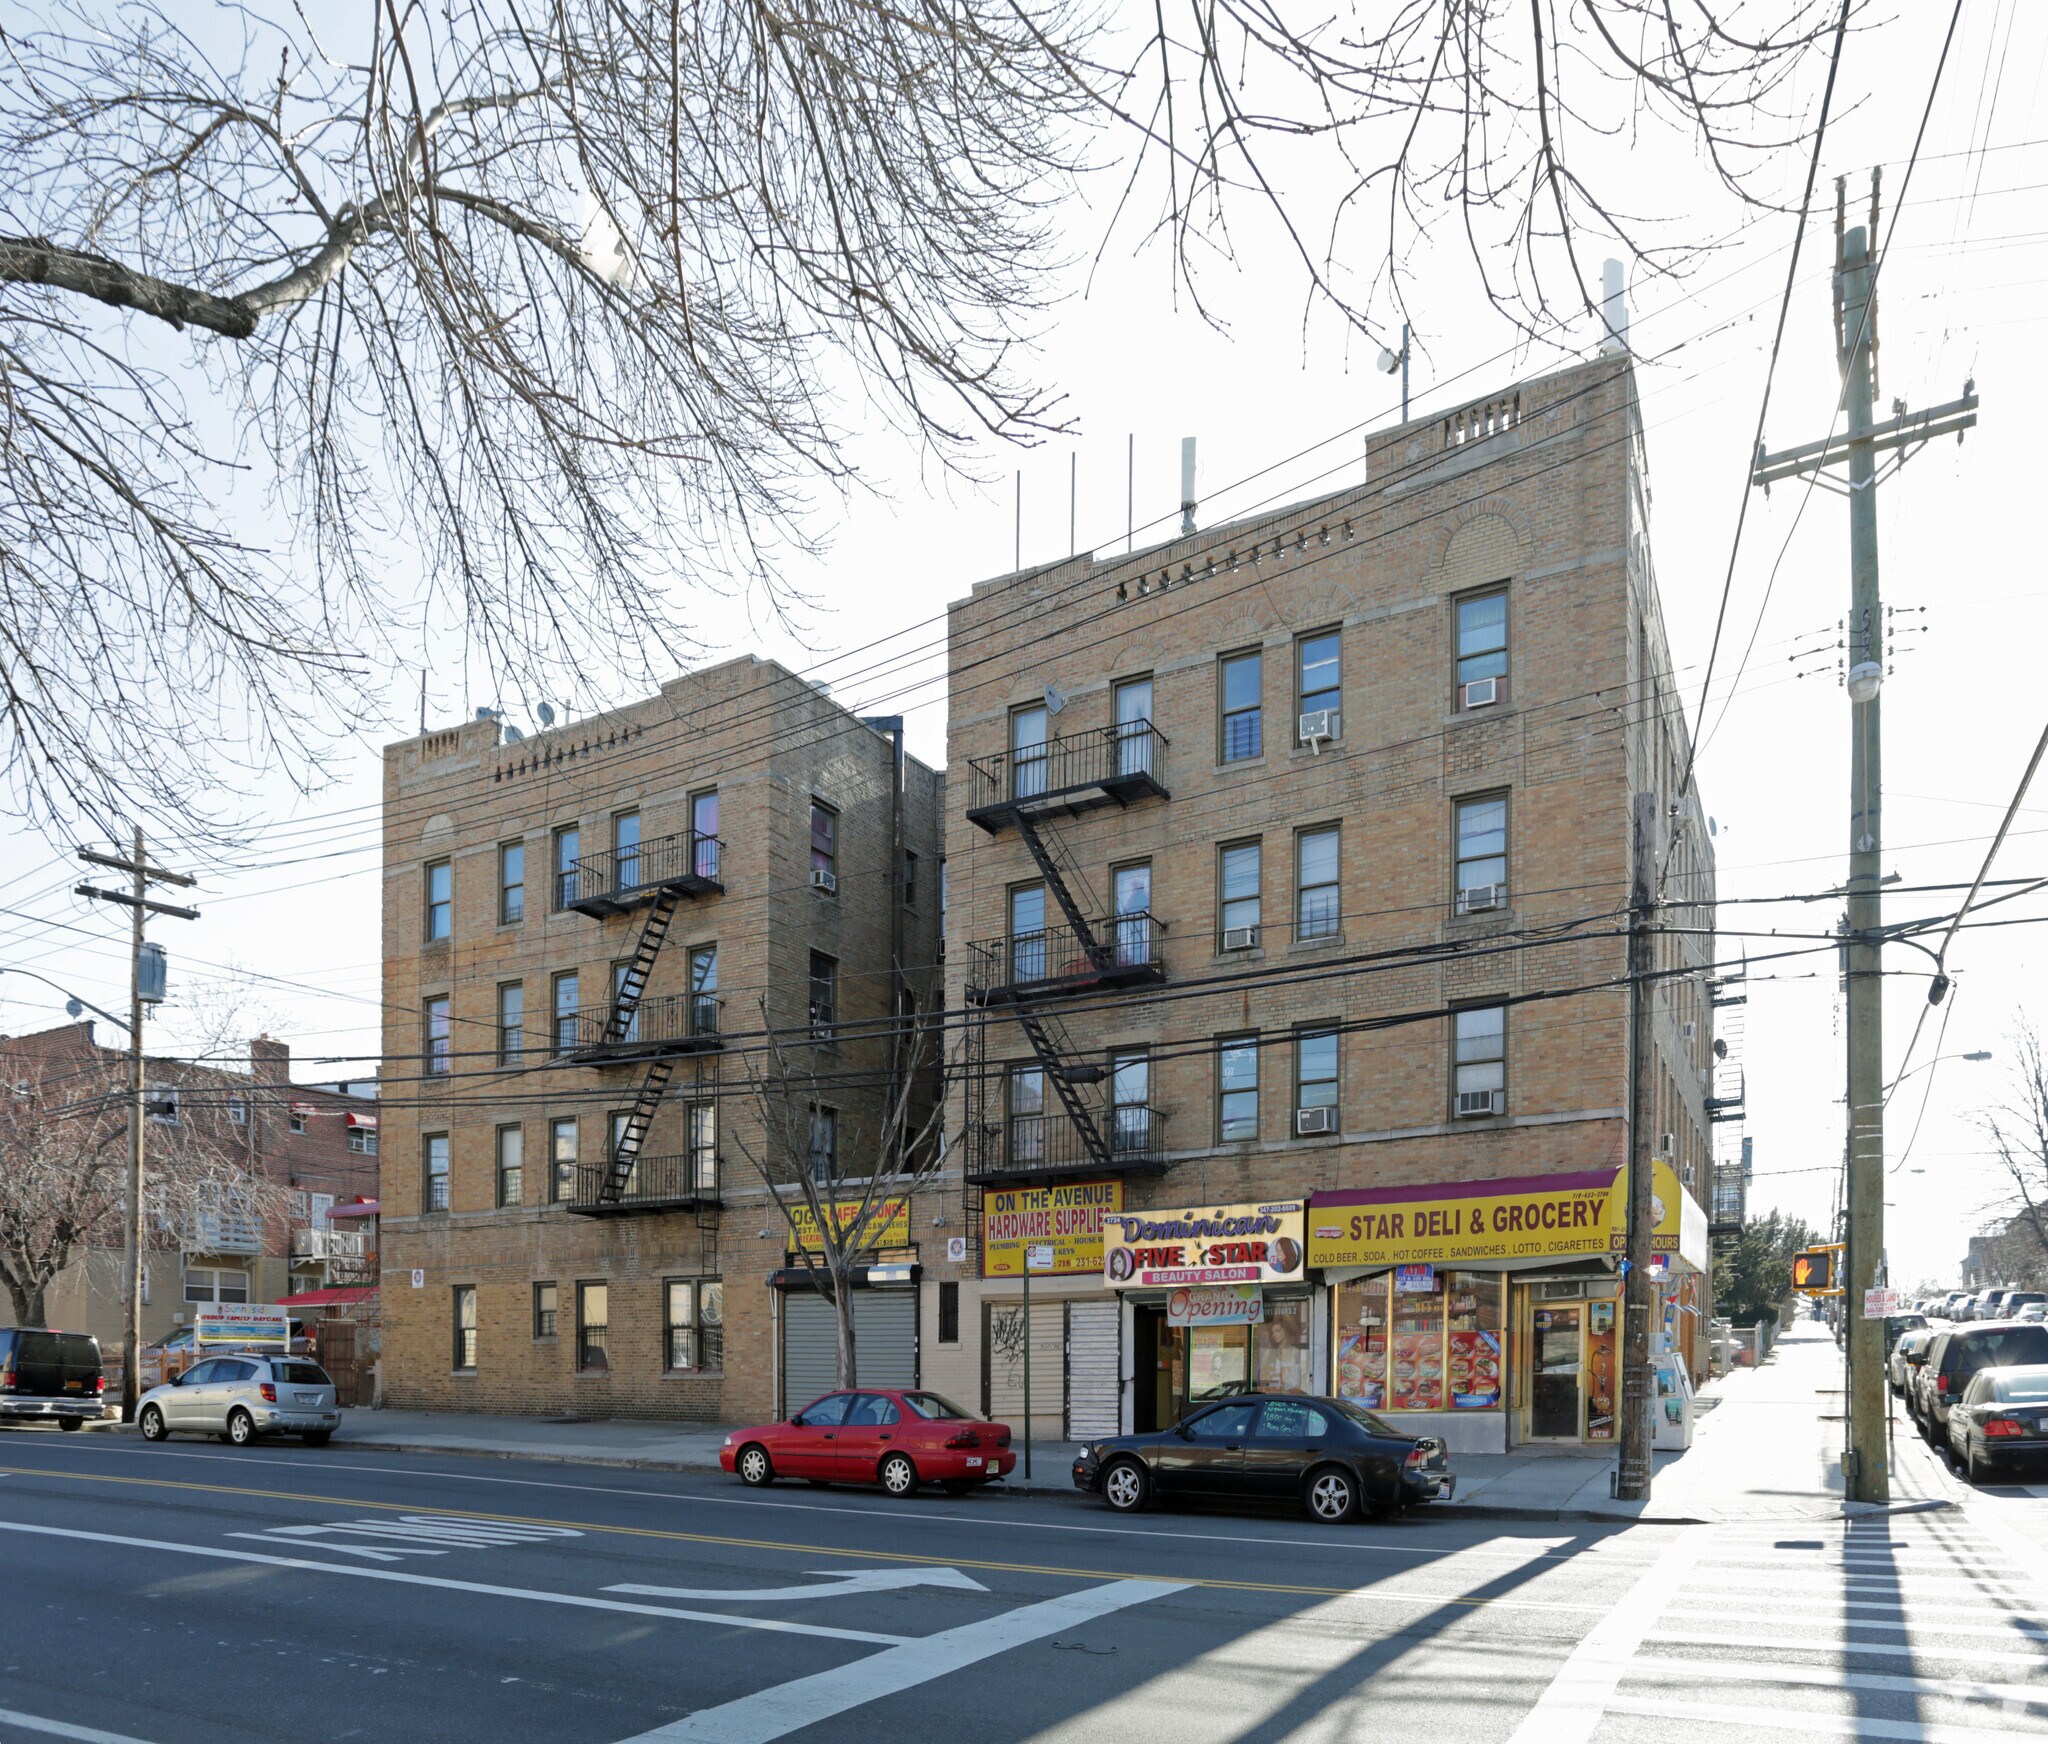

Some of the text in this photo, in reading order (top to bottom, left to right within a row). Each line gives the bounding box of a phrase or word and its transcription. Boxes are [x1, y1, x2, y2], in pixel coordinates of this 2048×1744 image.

[996, 1184, 1113, 1212] ON THE AVENUE
[988, 1206, 1112, 1241] HARDWARE SUPPLIE
[1121, 1210, 1281, 1243] Dominican
[1350, 1199, 1605, 1241] STAR DELI & GROCERY
[989, 1241, 1021, 1251] PLUMBING
[1074, 1236, 1097, 1245] HOUSE
[1058, 1248, 1075, 1256] KEYS
[1313, 1253, 1335, 1263] COLD
[1393, 1249, 1410, 1260] HOT
[1548, 1238, 1604, 1252] CIGARETTES
[1058, 1260, 1071, 1268] 718
[1134, 1241, 1269, 1268] FIVE STAR
[1152, 1268, 1247, 1283] BEAUTY SALON
[1404, 1264, 1426, 1275] ATM
[1189, 1290, 1230, 1302] GRAND
[1169, 1291, 1261, 1325] Opening
[1592, 1430, 1609, 1438] ATM
